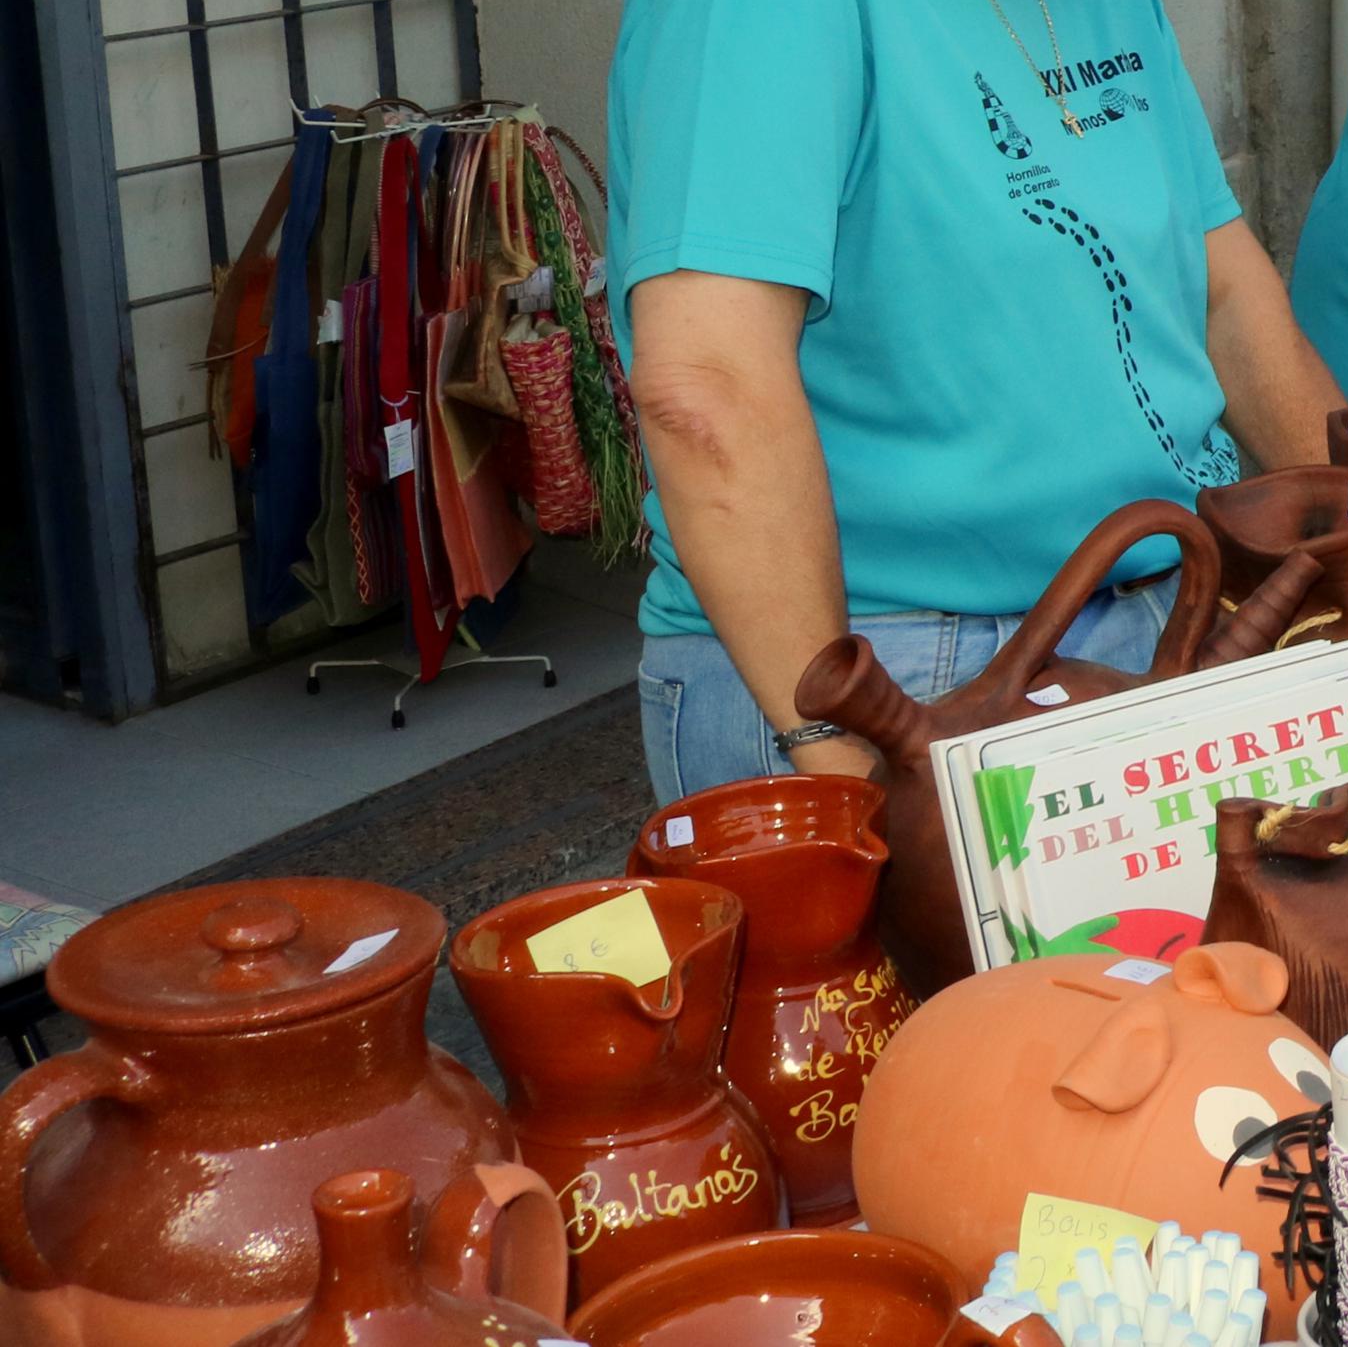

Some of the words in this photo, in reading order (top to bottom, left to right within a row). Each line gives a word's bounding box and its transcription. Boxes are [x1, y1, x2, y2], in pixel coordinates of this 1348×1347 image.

[1039, 65, 1077, 98] XXI
[1005, 164, 1052, 184] Hornillos
[1008, 186, 1021, 200] de
[1024, 178, 1060, 197] Cerrato
[1038, 781, 1105, 821] EL
[1038, 814, 1134, 864] DEL
[1122, 841, 1182, 881] DE
[563, 953, 579, 972] 8
[798, 1043, 846, 1081] de
[555, 1146, 760, 1256] Baltanás
[1038, 1204, 1109, 1240] BOLIS
